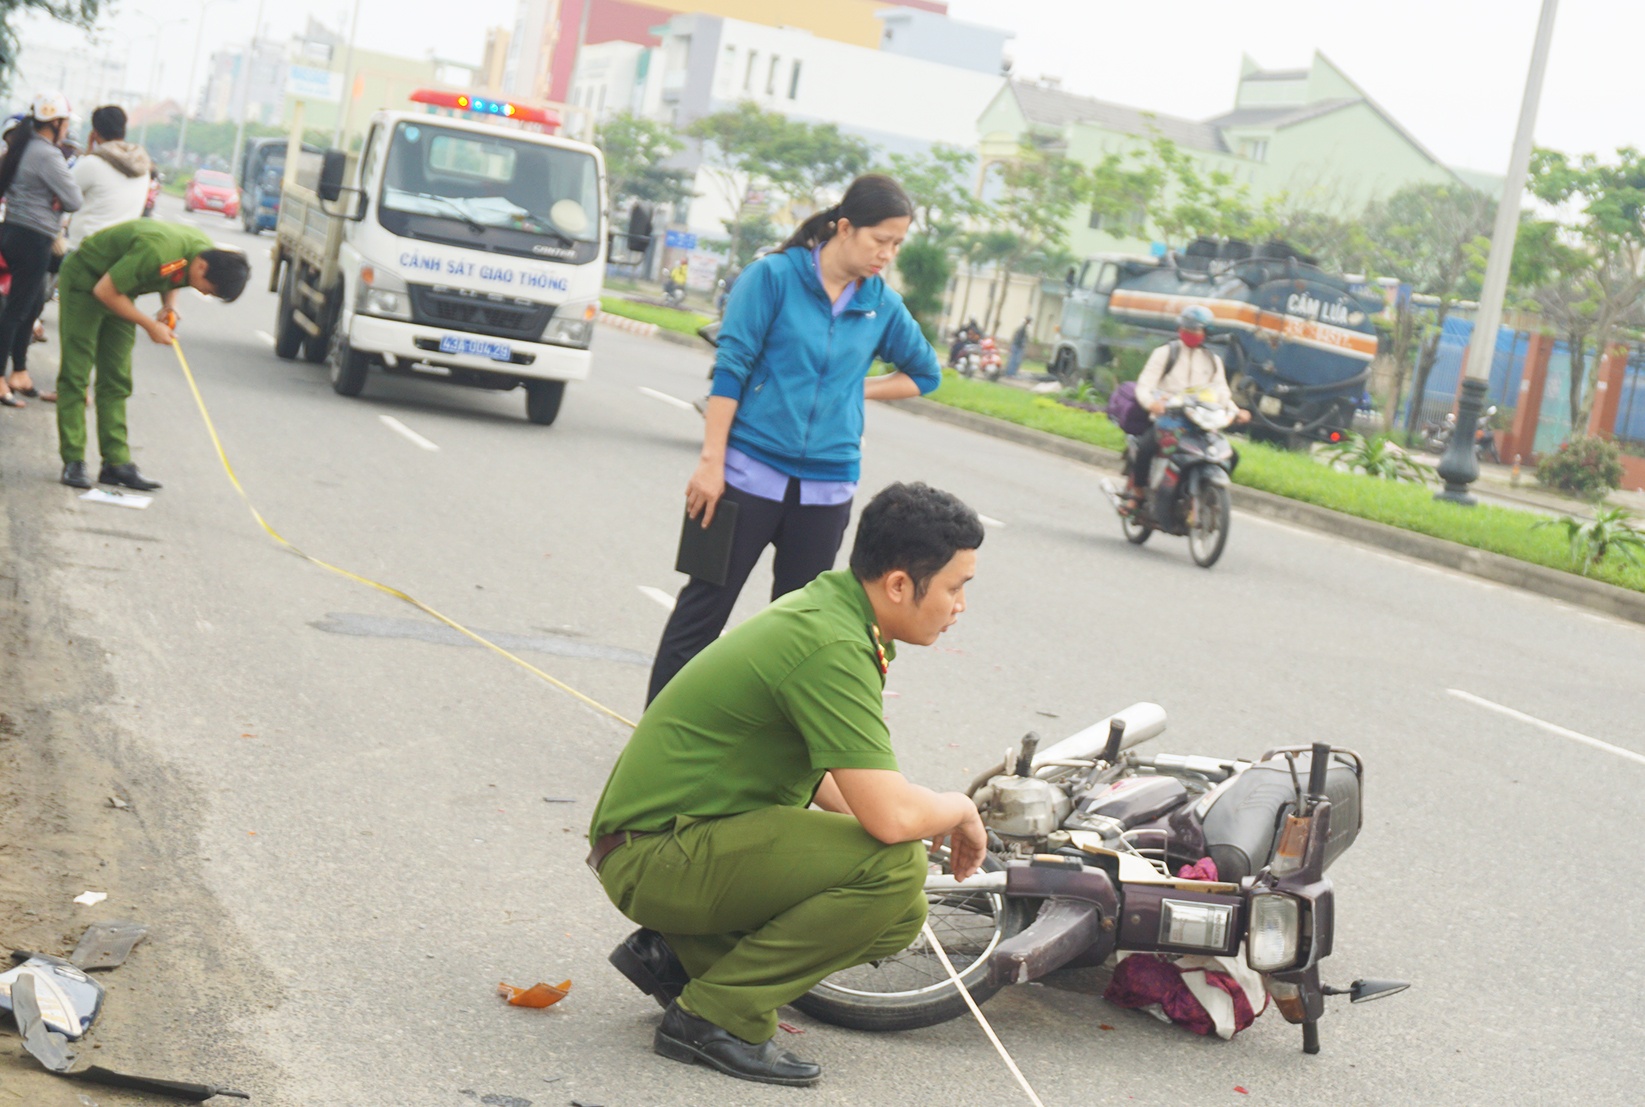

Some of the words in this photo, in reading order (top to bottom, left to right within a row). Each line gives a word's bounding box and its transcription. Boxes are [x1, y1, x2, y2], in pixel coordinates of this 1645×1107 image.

[400, 249, 441, 272] CẢNH
[446, 258, 475, 277] SÁT
[480, 264, 514, 284] GIAO
[519, 270, 568, 292] THÔNG
